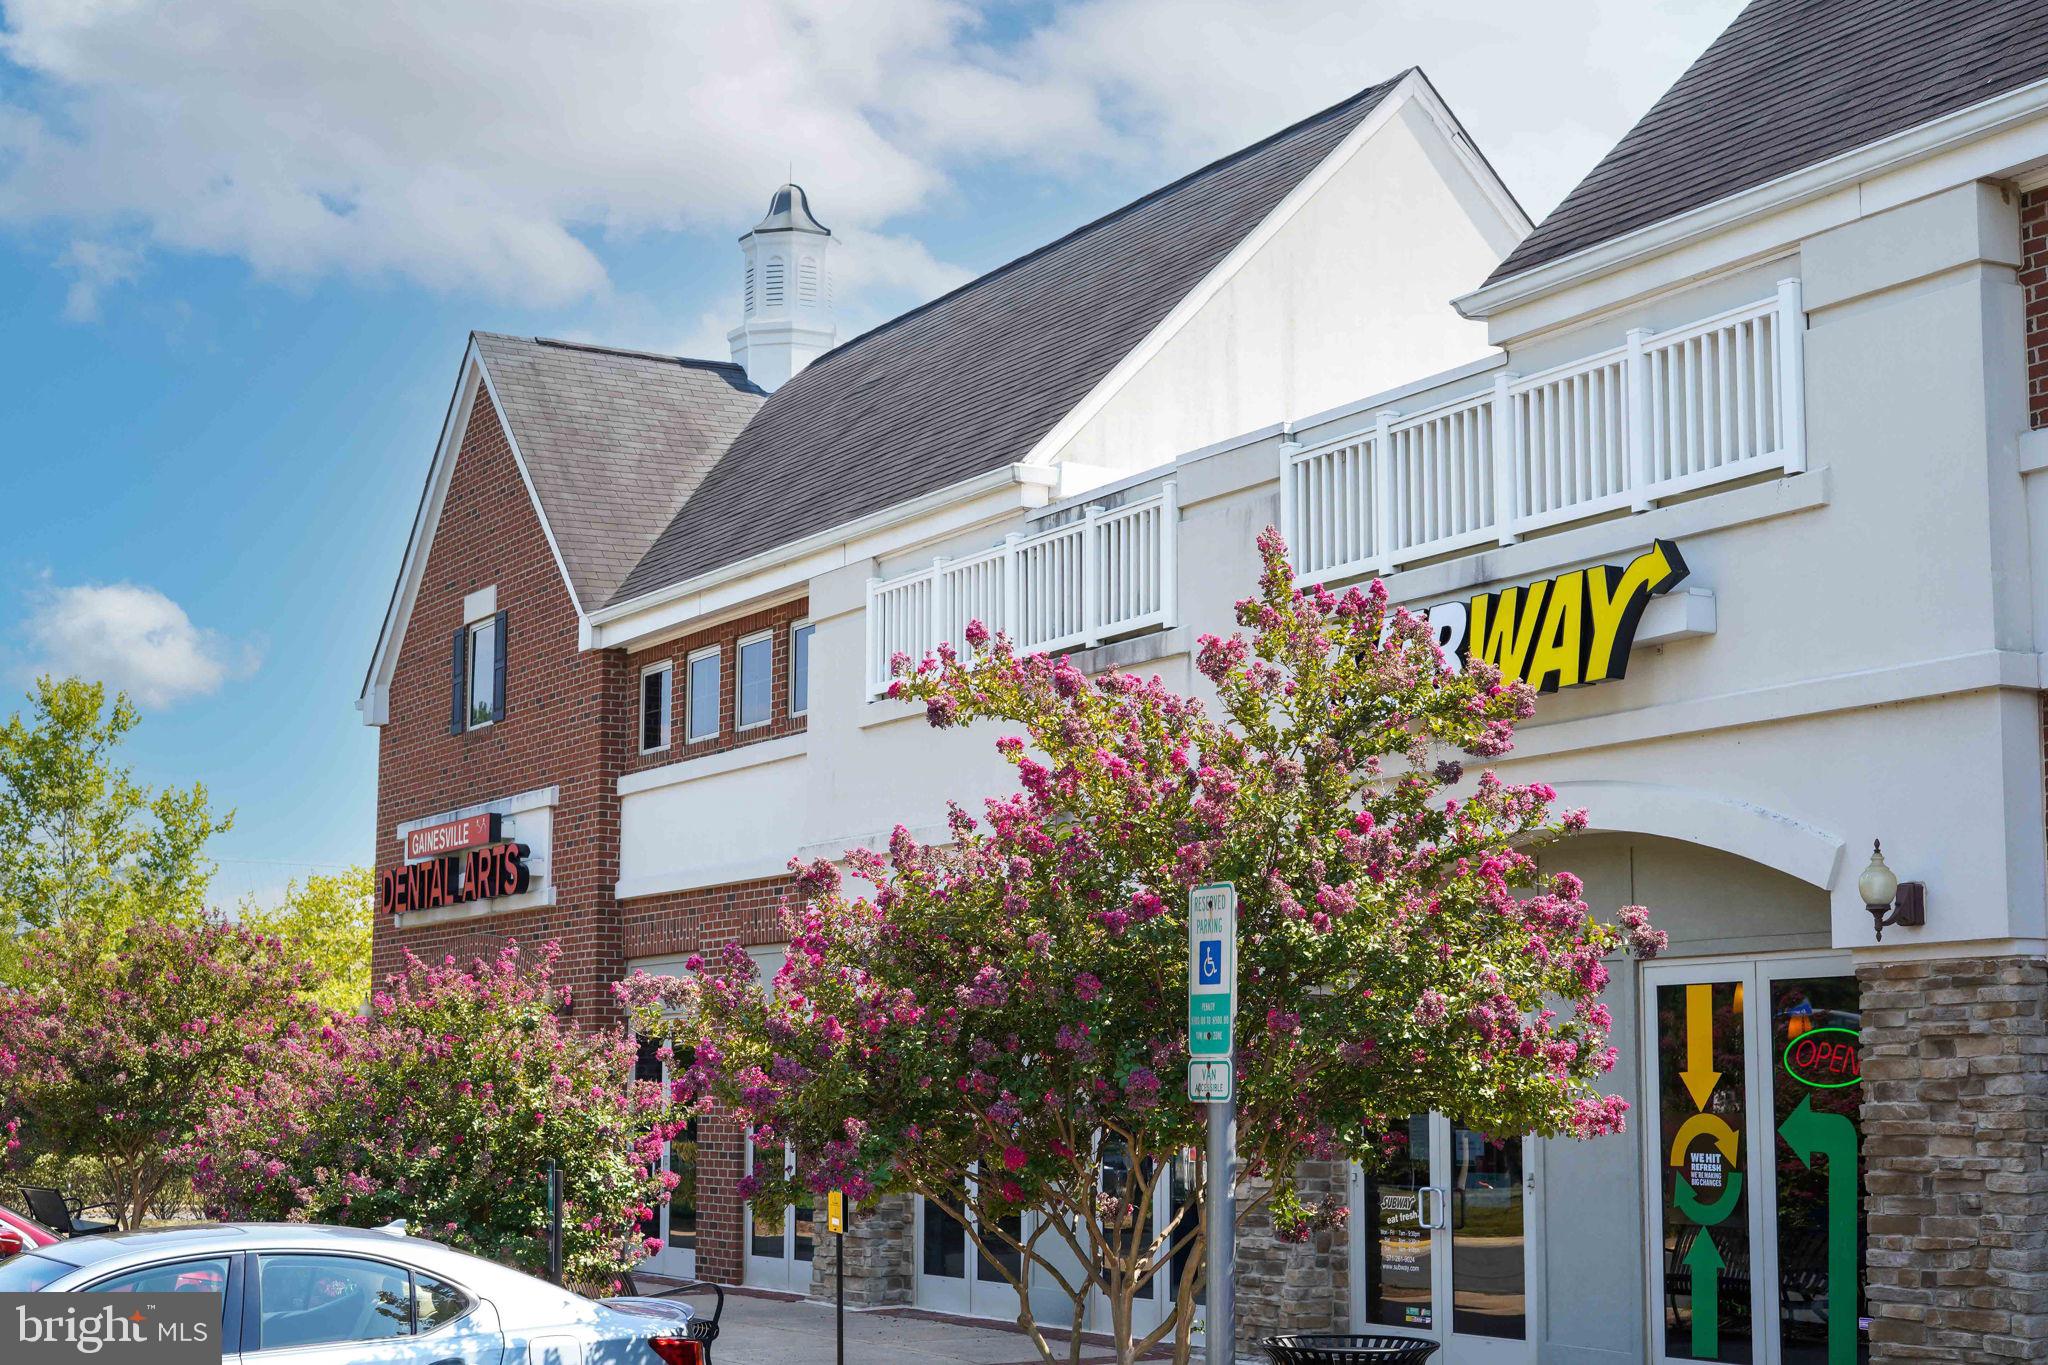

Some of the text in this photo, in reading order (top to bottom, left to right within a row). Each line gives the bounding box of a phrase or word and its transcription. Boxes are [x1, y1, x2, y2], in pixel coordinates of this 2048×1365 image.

[412, 823, 469, 855] GAINESVILLE
[382, 843, 520, 914] DENTAL ARTS
[1194, 894, 1226, 911] RESERVED
[1196, 918, 1222, 934] PARKING
[1795, 1039, 1861, 1076] OPEN
[1201, 1068, 1216, 1081] VAN
[1195, 1083, 1223, 1093] ACCESSIBLE
[1690, 1152, 1721, 1163] WE HIT
[1691, 1163, 1722, 1171] REFRESH
[1691, 1178, 1722, 1187] BIG CHANGES
[1381, 1195, 1416, 1210] SUBWAY
[1387, 1215, 1399, 1225] eat
